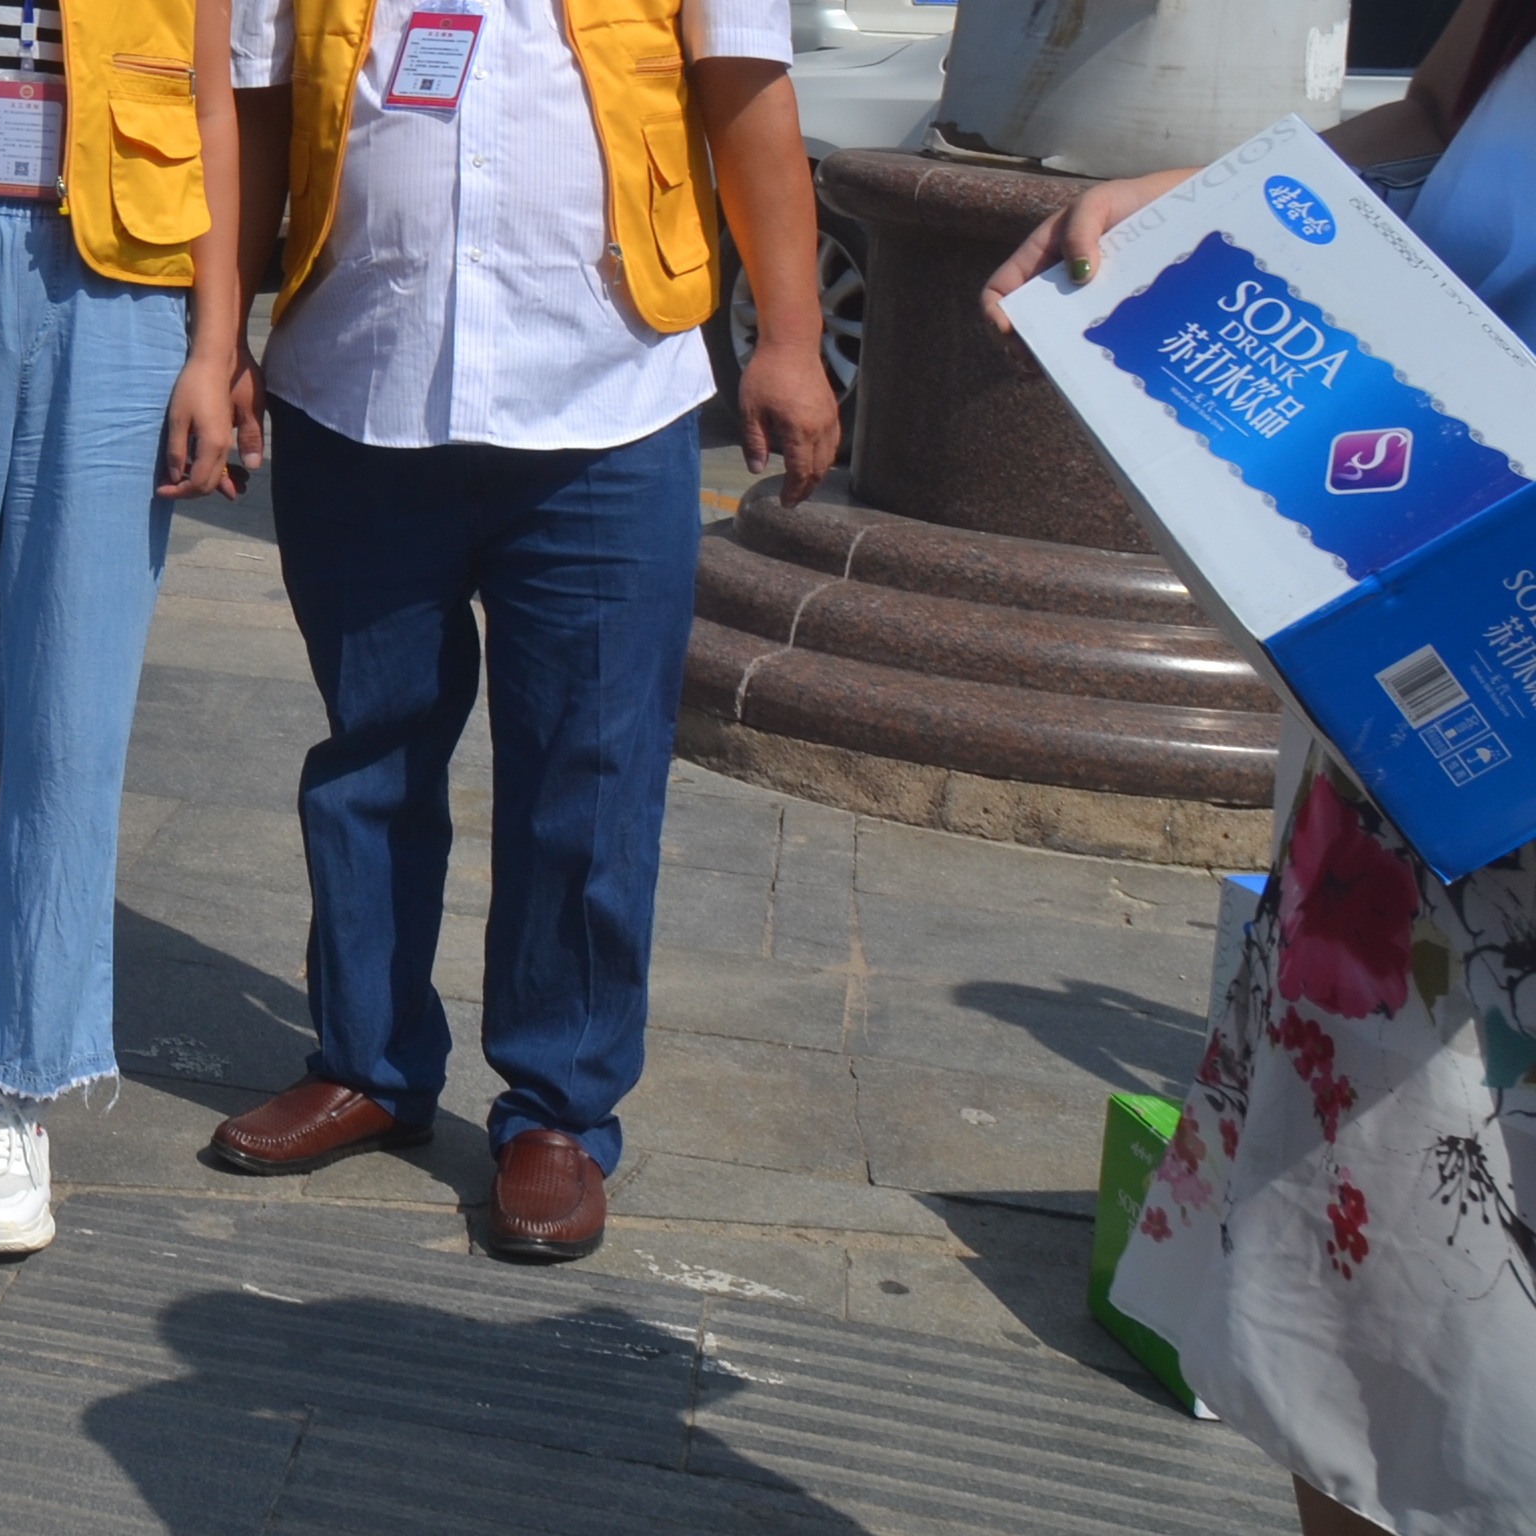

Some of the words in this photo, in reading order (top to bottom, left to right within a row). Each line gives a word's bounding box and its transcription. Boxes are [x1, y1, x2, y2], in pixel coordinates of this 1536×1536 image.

[1269, 186, 1330, 236] 娃哈哈
[1217, 280, 1349, 390] SODA
[1218, 320, 1305, 390] DRINK
[1157, 322, 1306, 440] 苏打水饮品
